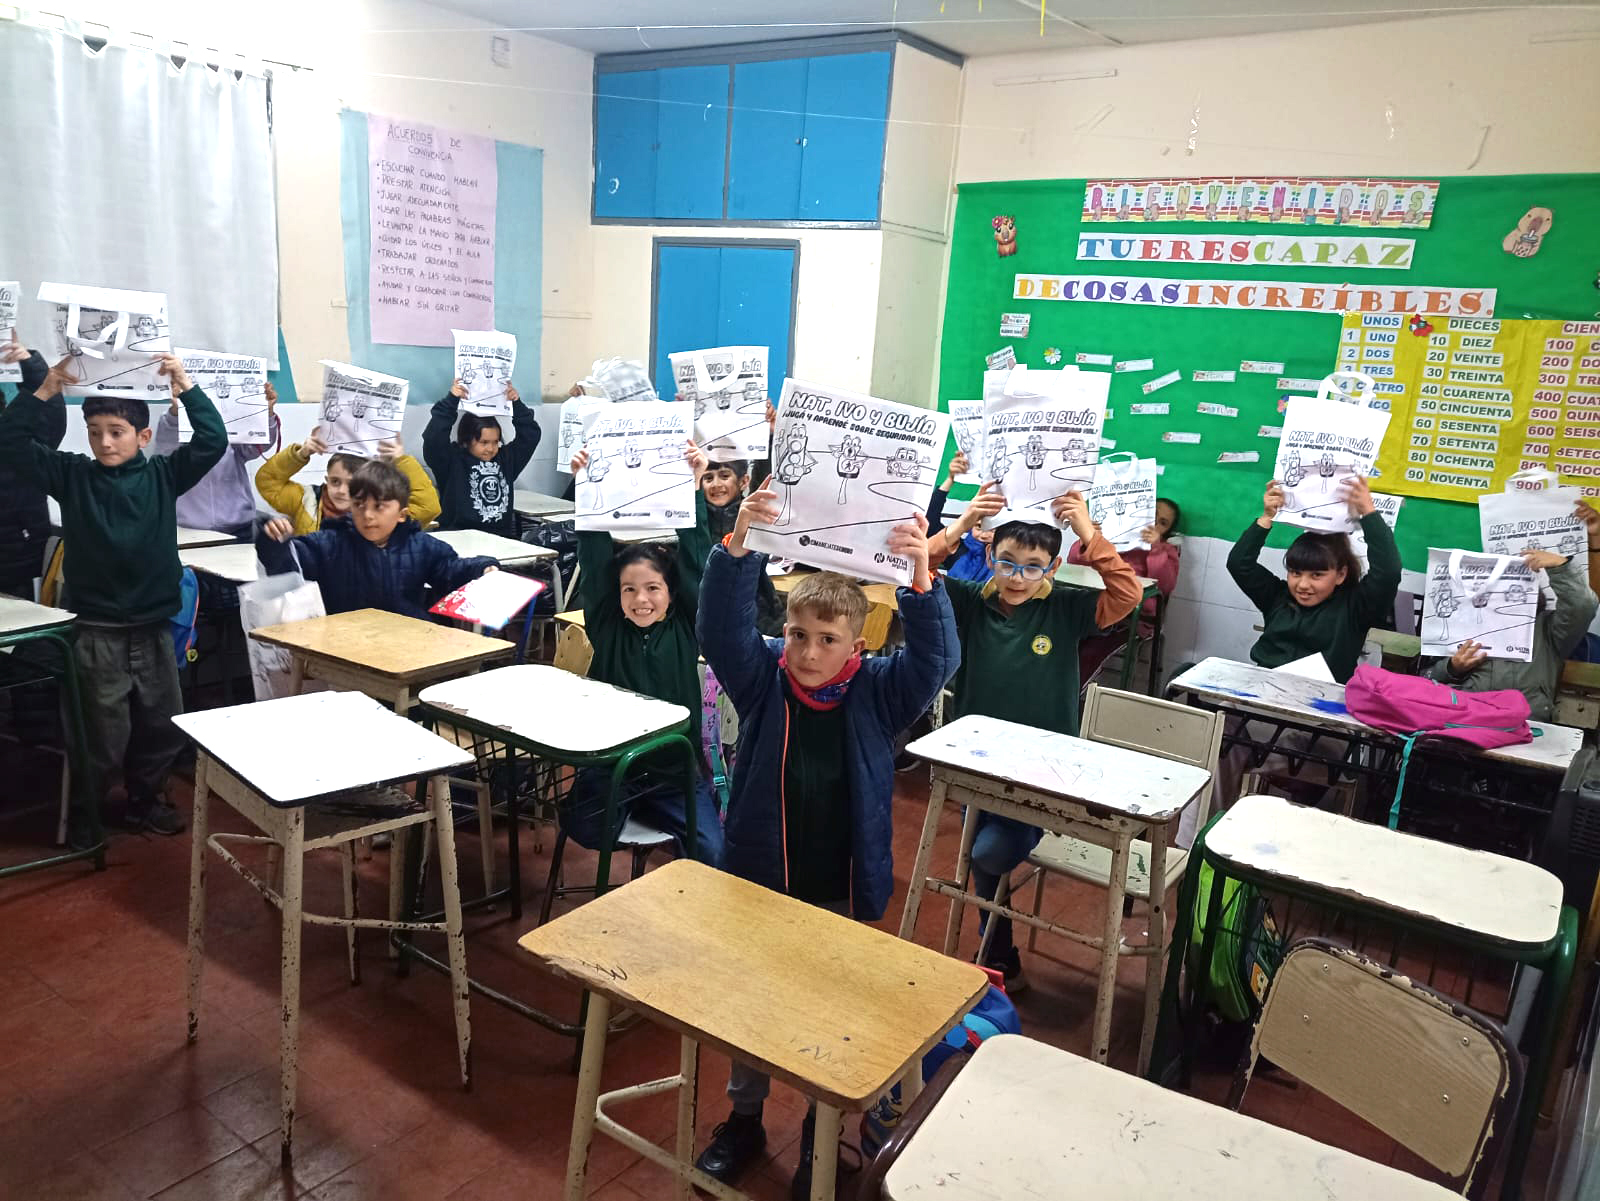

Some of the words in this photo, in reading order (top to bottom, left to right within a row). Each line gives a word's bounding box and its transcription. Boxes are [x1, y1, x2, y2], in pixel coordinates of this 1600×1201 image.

[388, 124, 432, 144] ACUERDOS
[449, 137, 462, 148] DE
[381, 160, 415, 175] ESCUCHAR
[419, 169, 446, 181] CUANDO
[382, 174, 414, 189] PRESTAR
[380, 190, 402, 202] JUGAR
[380, 205, 400, 215] USAR
[381, 249, 417, 261] TRABAJAR
[383, 296, 410, 307] HABLAR
[435, 303, 460, 313] GRITAR
[1363, 316, 1399, 326] UNOS
[1449, 320, 1500, 331] DIECES
[1347, 330, 1353, 340] 1
[1370, 333, 1395, 342] UNO
[1432, 336, 1446, 346] 10
[1462, 338, 1492, 348] DIEZ
[1547, 340, 1574, 350] 100
[1347, 349, 1355, 358] 2
[1366, 349, 1390, 358] DOS
[1429, 352, 1445, 361] 20
[1454, 353, 1500, 365] VEINTE
[1542, 357, 1569, 367] 200
[1363, 366, 1394, 375] TRES
[1427, 368, 1442, 377] 30
[1450, 371, 1504, 383] TREINTA
[1539, 374, 1566, 384] 300
[1340, 381, 1348, 390] 4
[1356, 381, 1404, 393] CATRO
[1421, 385, 1438, 395] 40
[1443, 388, 1510, 402] CUARENTA
[1534, 391, 1562, 402] 400
[1420, 401, 1437, 410] 50
[1440, 403, 1512, 418] CINCUENTA
[1531, 409, 1558, 419] 500
[835, 400, 867, 422] IVO
[870, 409, 882, 426] Y
[883, 412, 937, 436] BUJÍA
[1022, 411, 1044, 424] IVO
[1056, 408, 1097, 426] BUJÍA
[850, 423, 876, 435] SOBRE
[1416, 419, 1432, 429] 60
[1440, 421, 1497, 434] SESENTA
[1528, 426, 1554, 436] 600
[1316, 432, 1337, 444] IVO
[1413, 436, 1429, 446] 70
[1438, 437, 1496, 451] SETENTA
[1524, 444, 1550, 455] 700
[1411, 453, 1427, 462] 80
[1435, 454, 1495, 469] OCHENTA
[1408, 470, 1424, 480] 90
[1430, 473, 1489, 488] NOVENTA
[1516, 481, 1542, 491] 900
[1518, 520, 1537, 532] IVO
[886, 555, 908, 568] NATIVA
